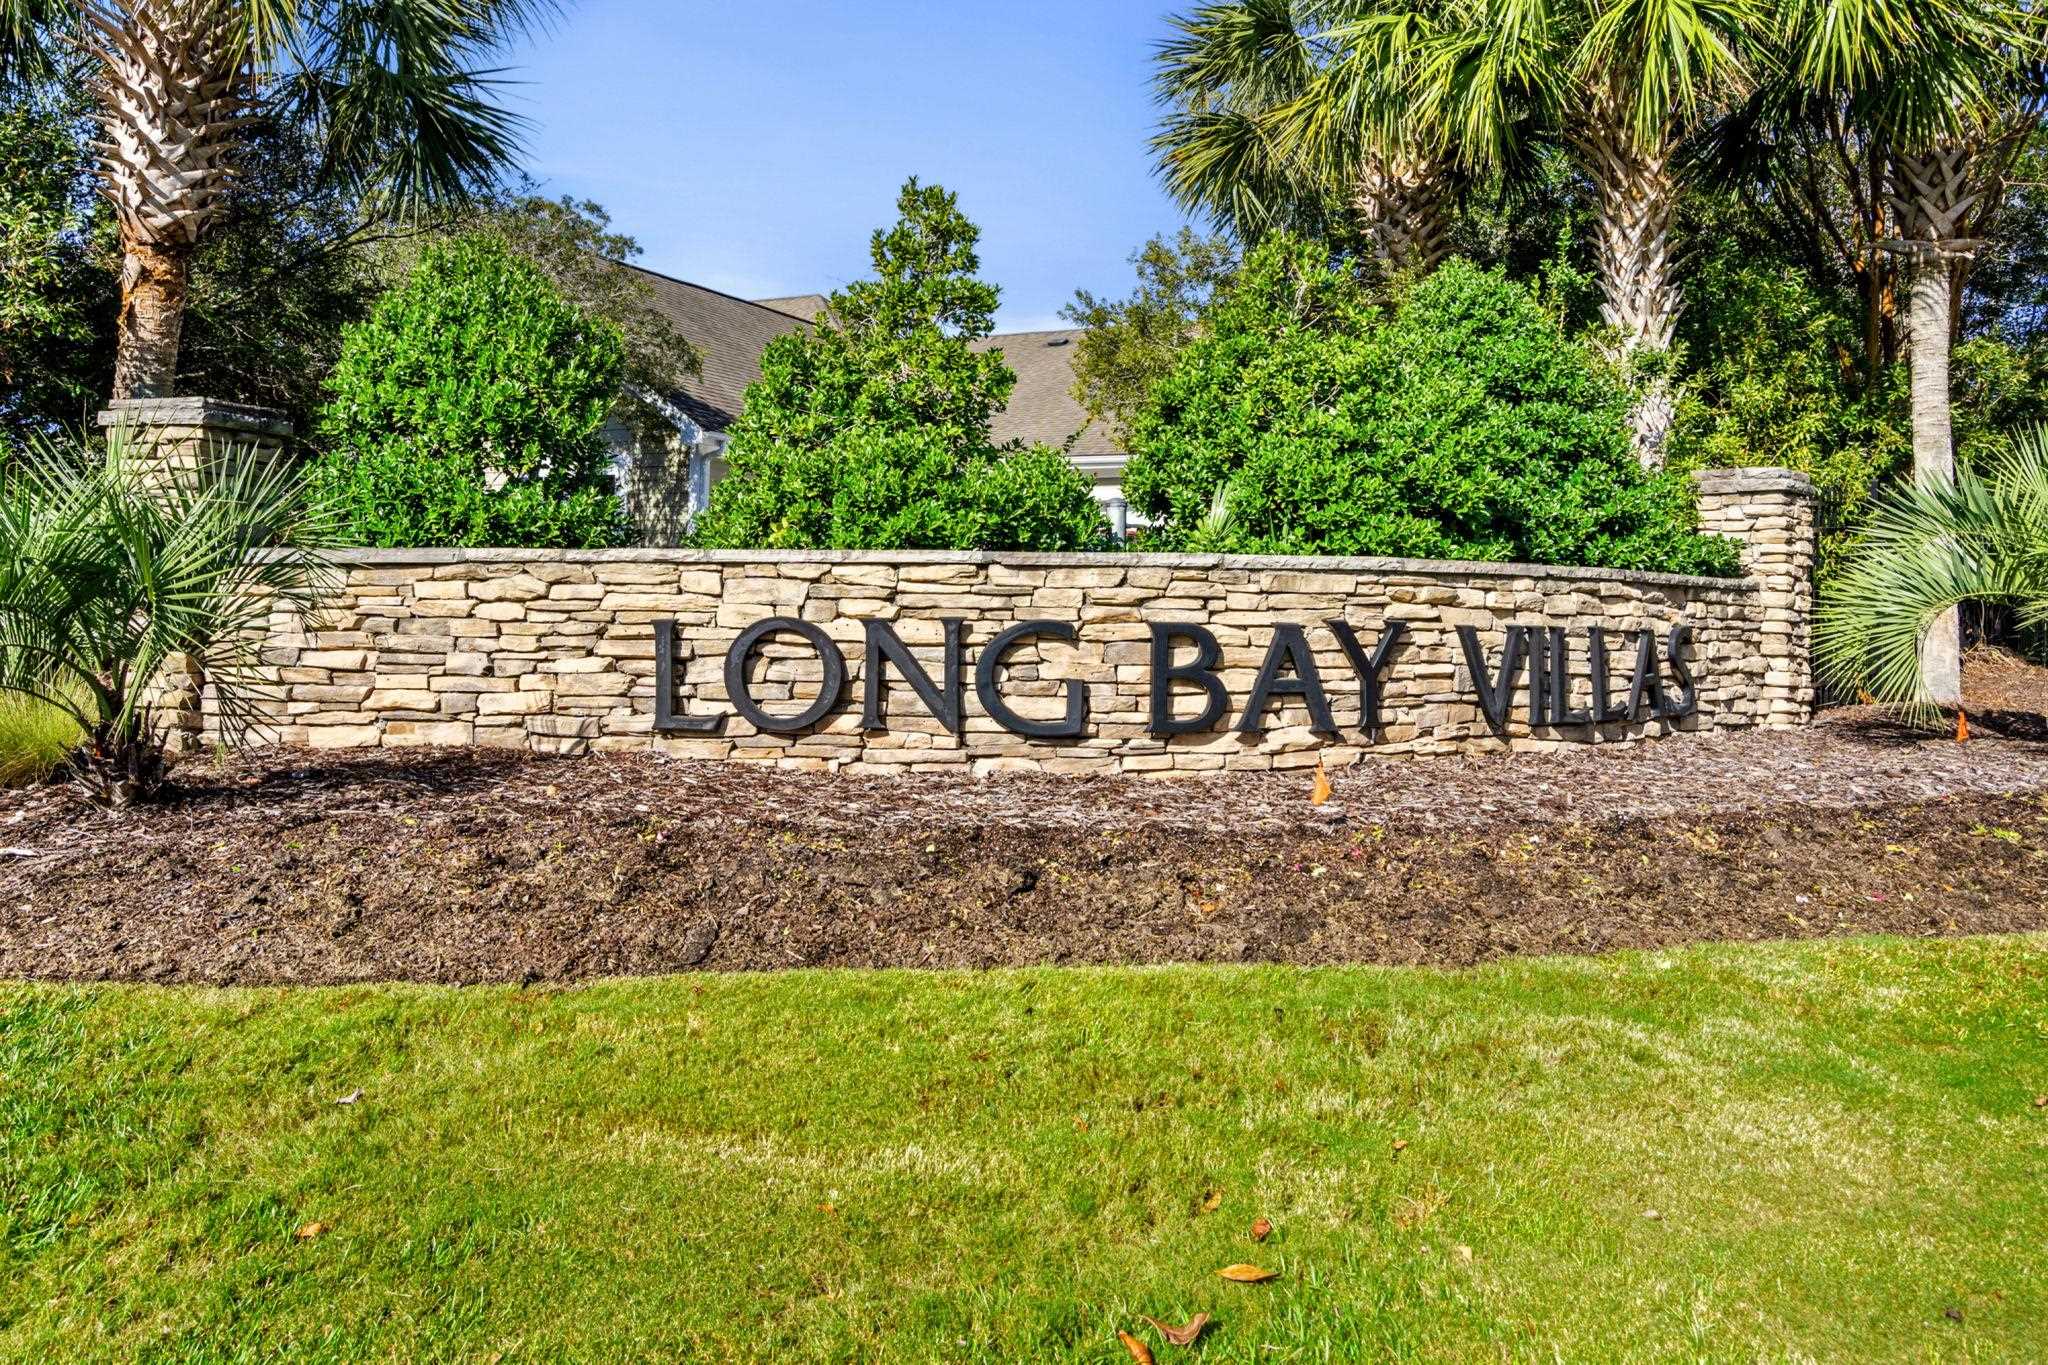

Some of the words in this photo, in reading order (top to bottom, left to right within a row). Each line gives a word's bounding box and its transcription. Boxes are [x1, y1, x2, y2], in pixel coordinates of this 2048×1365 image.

[652, 616, 1085, 738] LONG
[1143, 618, 1407, 734] BAY
[1454, 623, 1697, 736] VILLAS
